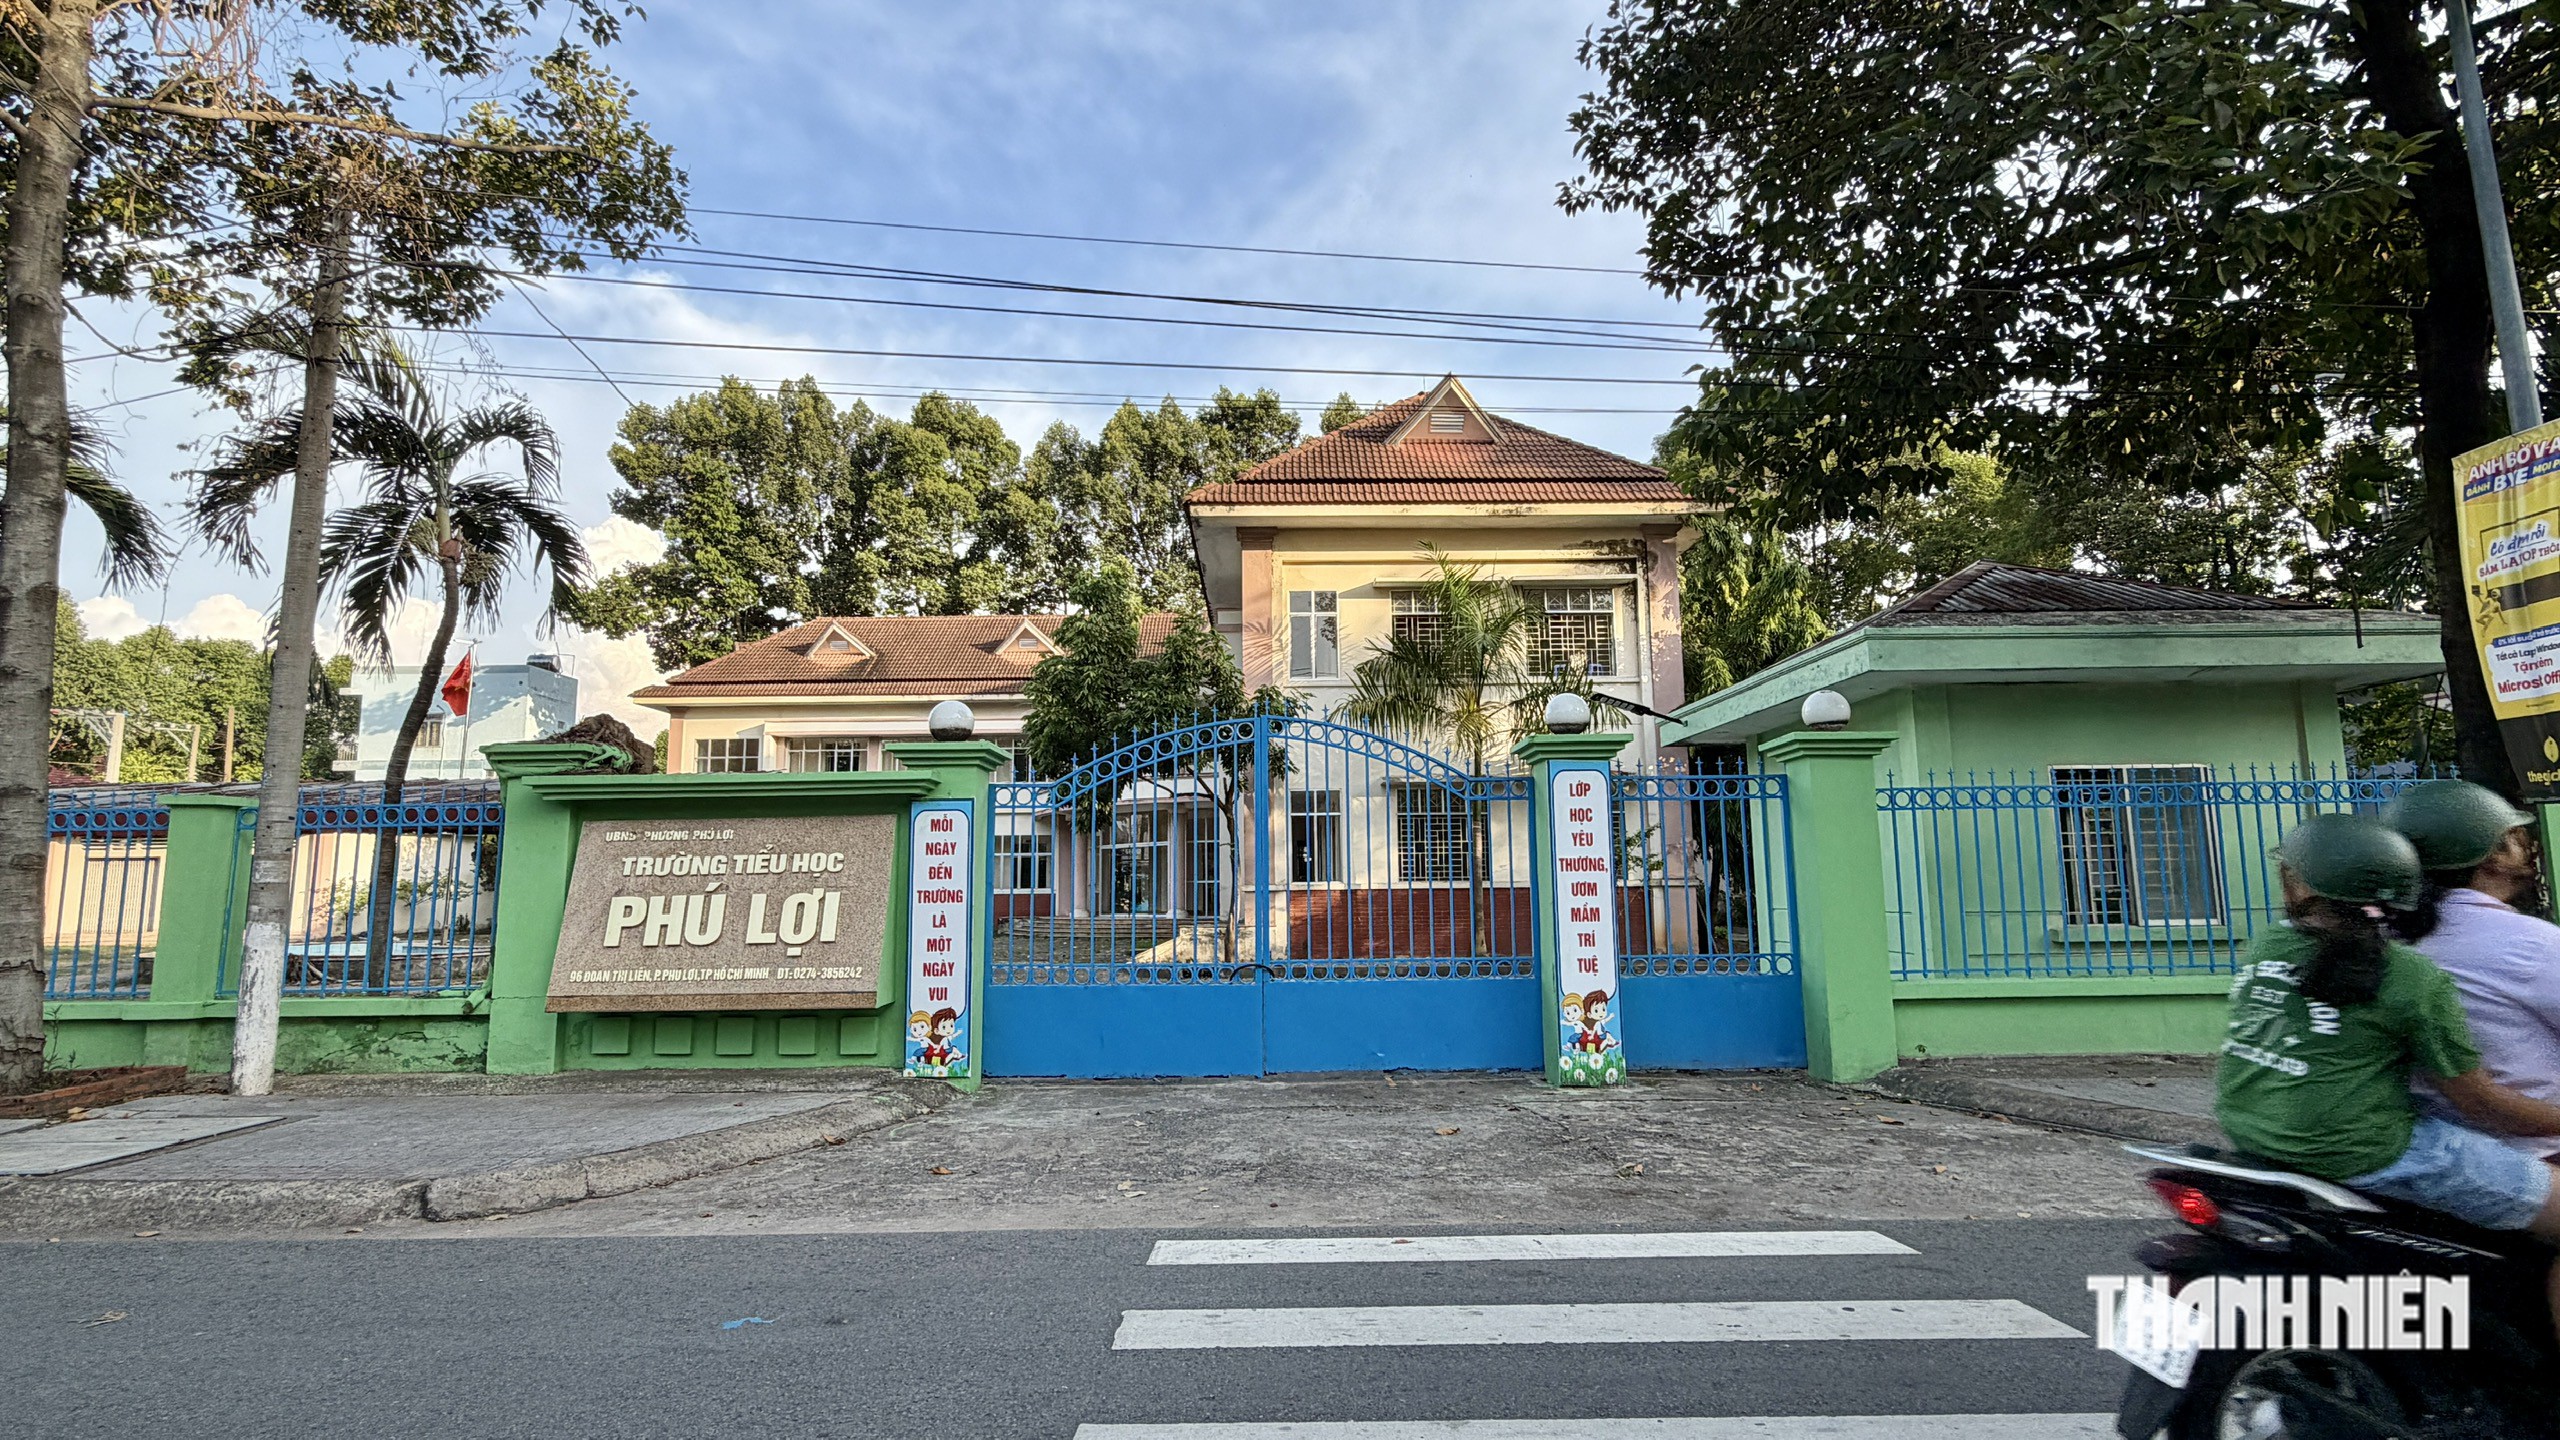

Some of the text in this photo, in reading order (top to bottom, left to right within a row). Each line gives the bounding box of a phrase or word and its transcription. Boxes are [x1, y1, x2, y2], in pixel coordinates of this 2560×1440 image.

[2469, 456, 2503, 481] ANH
[2493, 466, 2529, 492] BYE
[1569, 780, 1591, 797] LỚP
[930, 813, 953, 832] MỖI
[1569, 808, 1593, 825] HỌC
[925, 838, 957, 856] NGÀY
[1571, 829, 1593, 847] YÊU
[621, 844, 845, 878] TRƯỜNG TIỂU HỌC
[1559, 856, 1608, 873] THƯƠNG,
[928, 861, 952, 880] ĐẾN
[917, 887, 963, 904] TRƯỜNG
[1571, 881, 1598, 897] ƯƠM
[603, 882, 841, 957] PHÚ LỢI
[932, 910, 947, 928] LÀ
[1571, 902, 1600, 922] MẦM
[926, 935, 952, 955] MỘT
[1577, 930, 1596, 947] TRÍ
[569, 970, 583, 982] 96
[744, 967, 770, 980] MINH
[922, 959, 955, 977] NGÀY
[1577, 954, 1598, 977] TUỆ
[928, 987, 948, 1001] VUI
